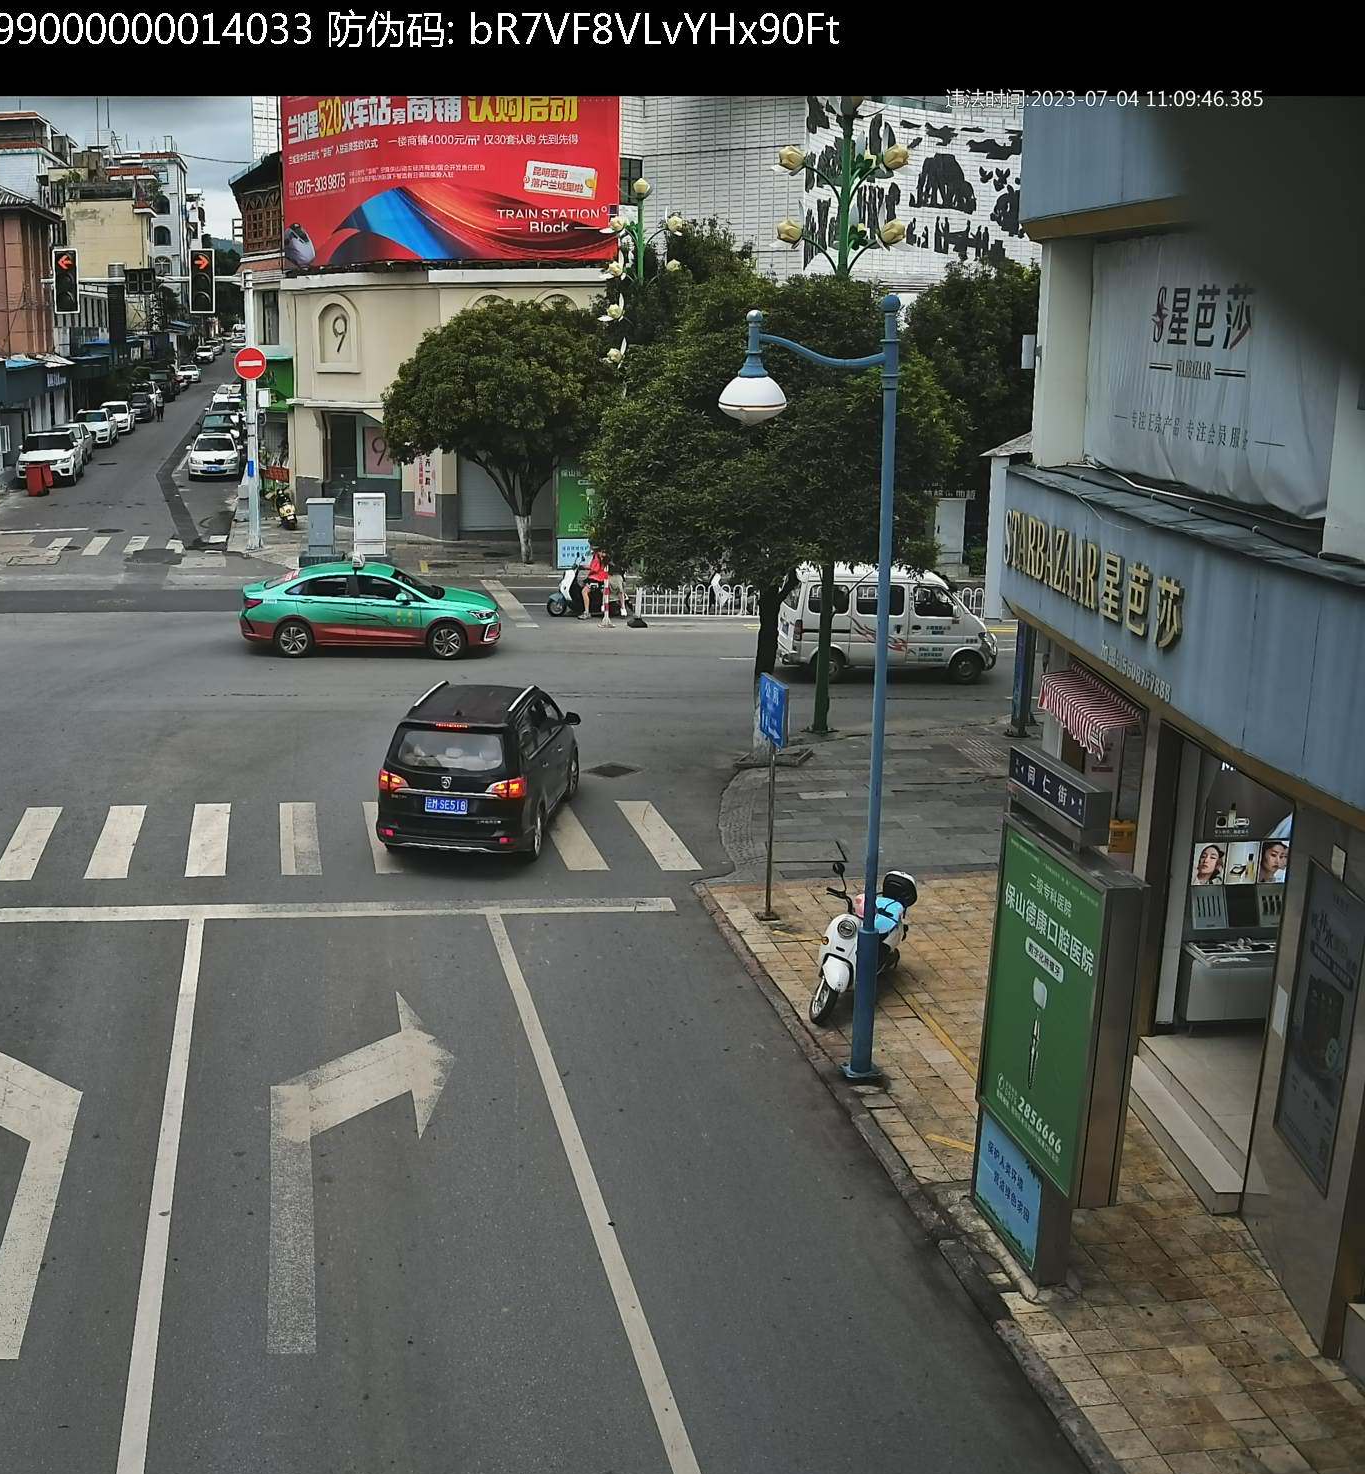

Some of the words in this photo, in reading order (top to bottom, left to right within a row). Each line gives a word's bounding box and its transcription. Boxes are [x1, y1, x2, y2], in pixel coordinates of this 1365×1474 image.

[538, 133, 579, 146] 先到先得
[497, 209, 538, 219] TRAIN
[541, 209, 600, 219] STATION
[529, 221, 569, 233] Block
[1166, 283, 1257, 350] 星芭莎
[1003, 508, 1101, 611] STARBAZAAR
[1100, 550, 1185, 649] 星芭莎
[1027, 764, 1068, 807] 同仁街
[1029, 873, 1073, 918] 二级专科医院
[1004, 881, 1095, 977] 保山德康口腔医院
[1017, 1096, 1062, 1154] 2856666
